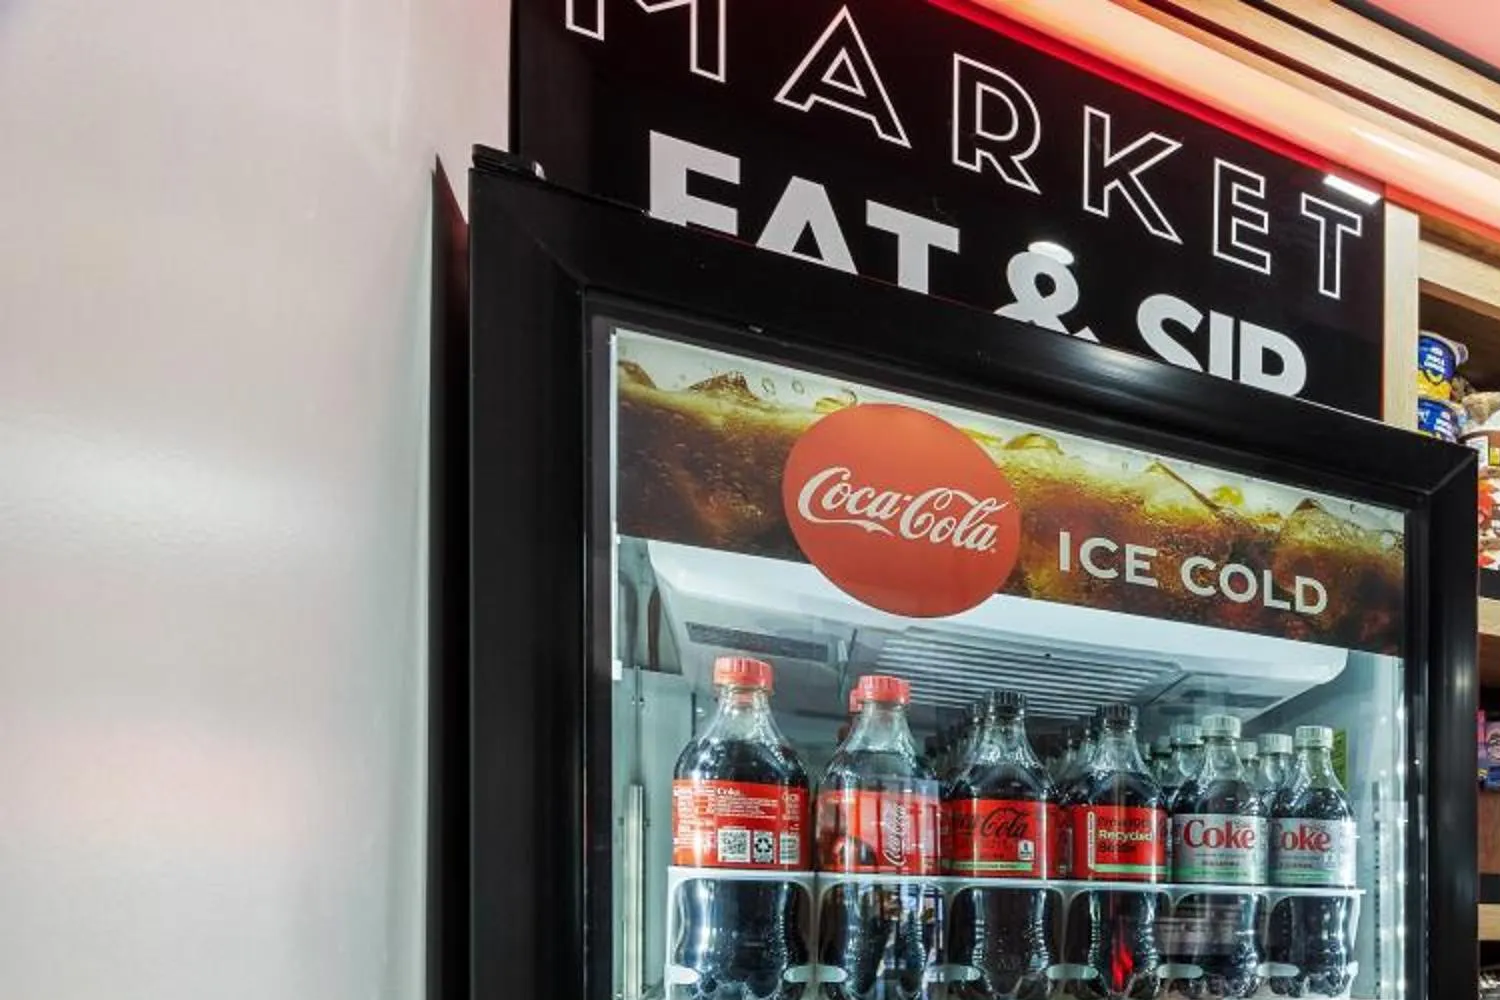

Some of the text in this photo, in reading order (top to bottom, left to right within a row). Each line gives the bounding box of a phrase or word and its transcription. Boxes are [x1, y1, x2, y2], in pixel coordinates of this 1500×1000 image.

[797, 464, 1009, 553] Coca-Cola
[1058, 530, 1328, 616] ICE COLD
[1183, 819, 1256, 851] Coke
